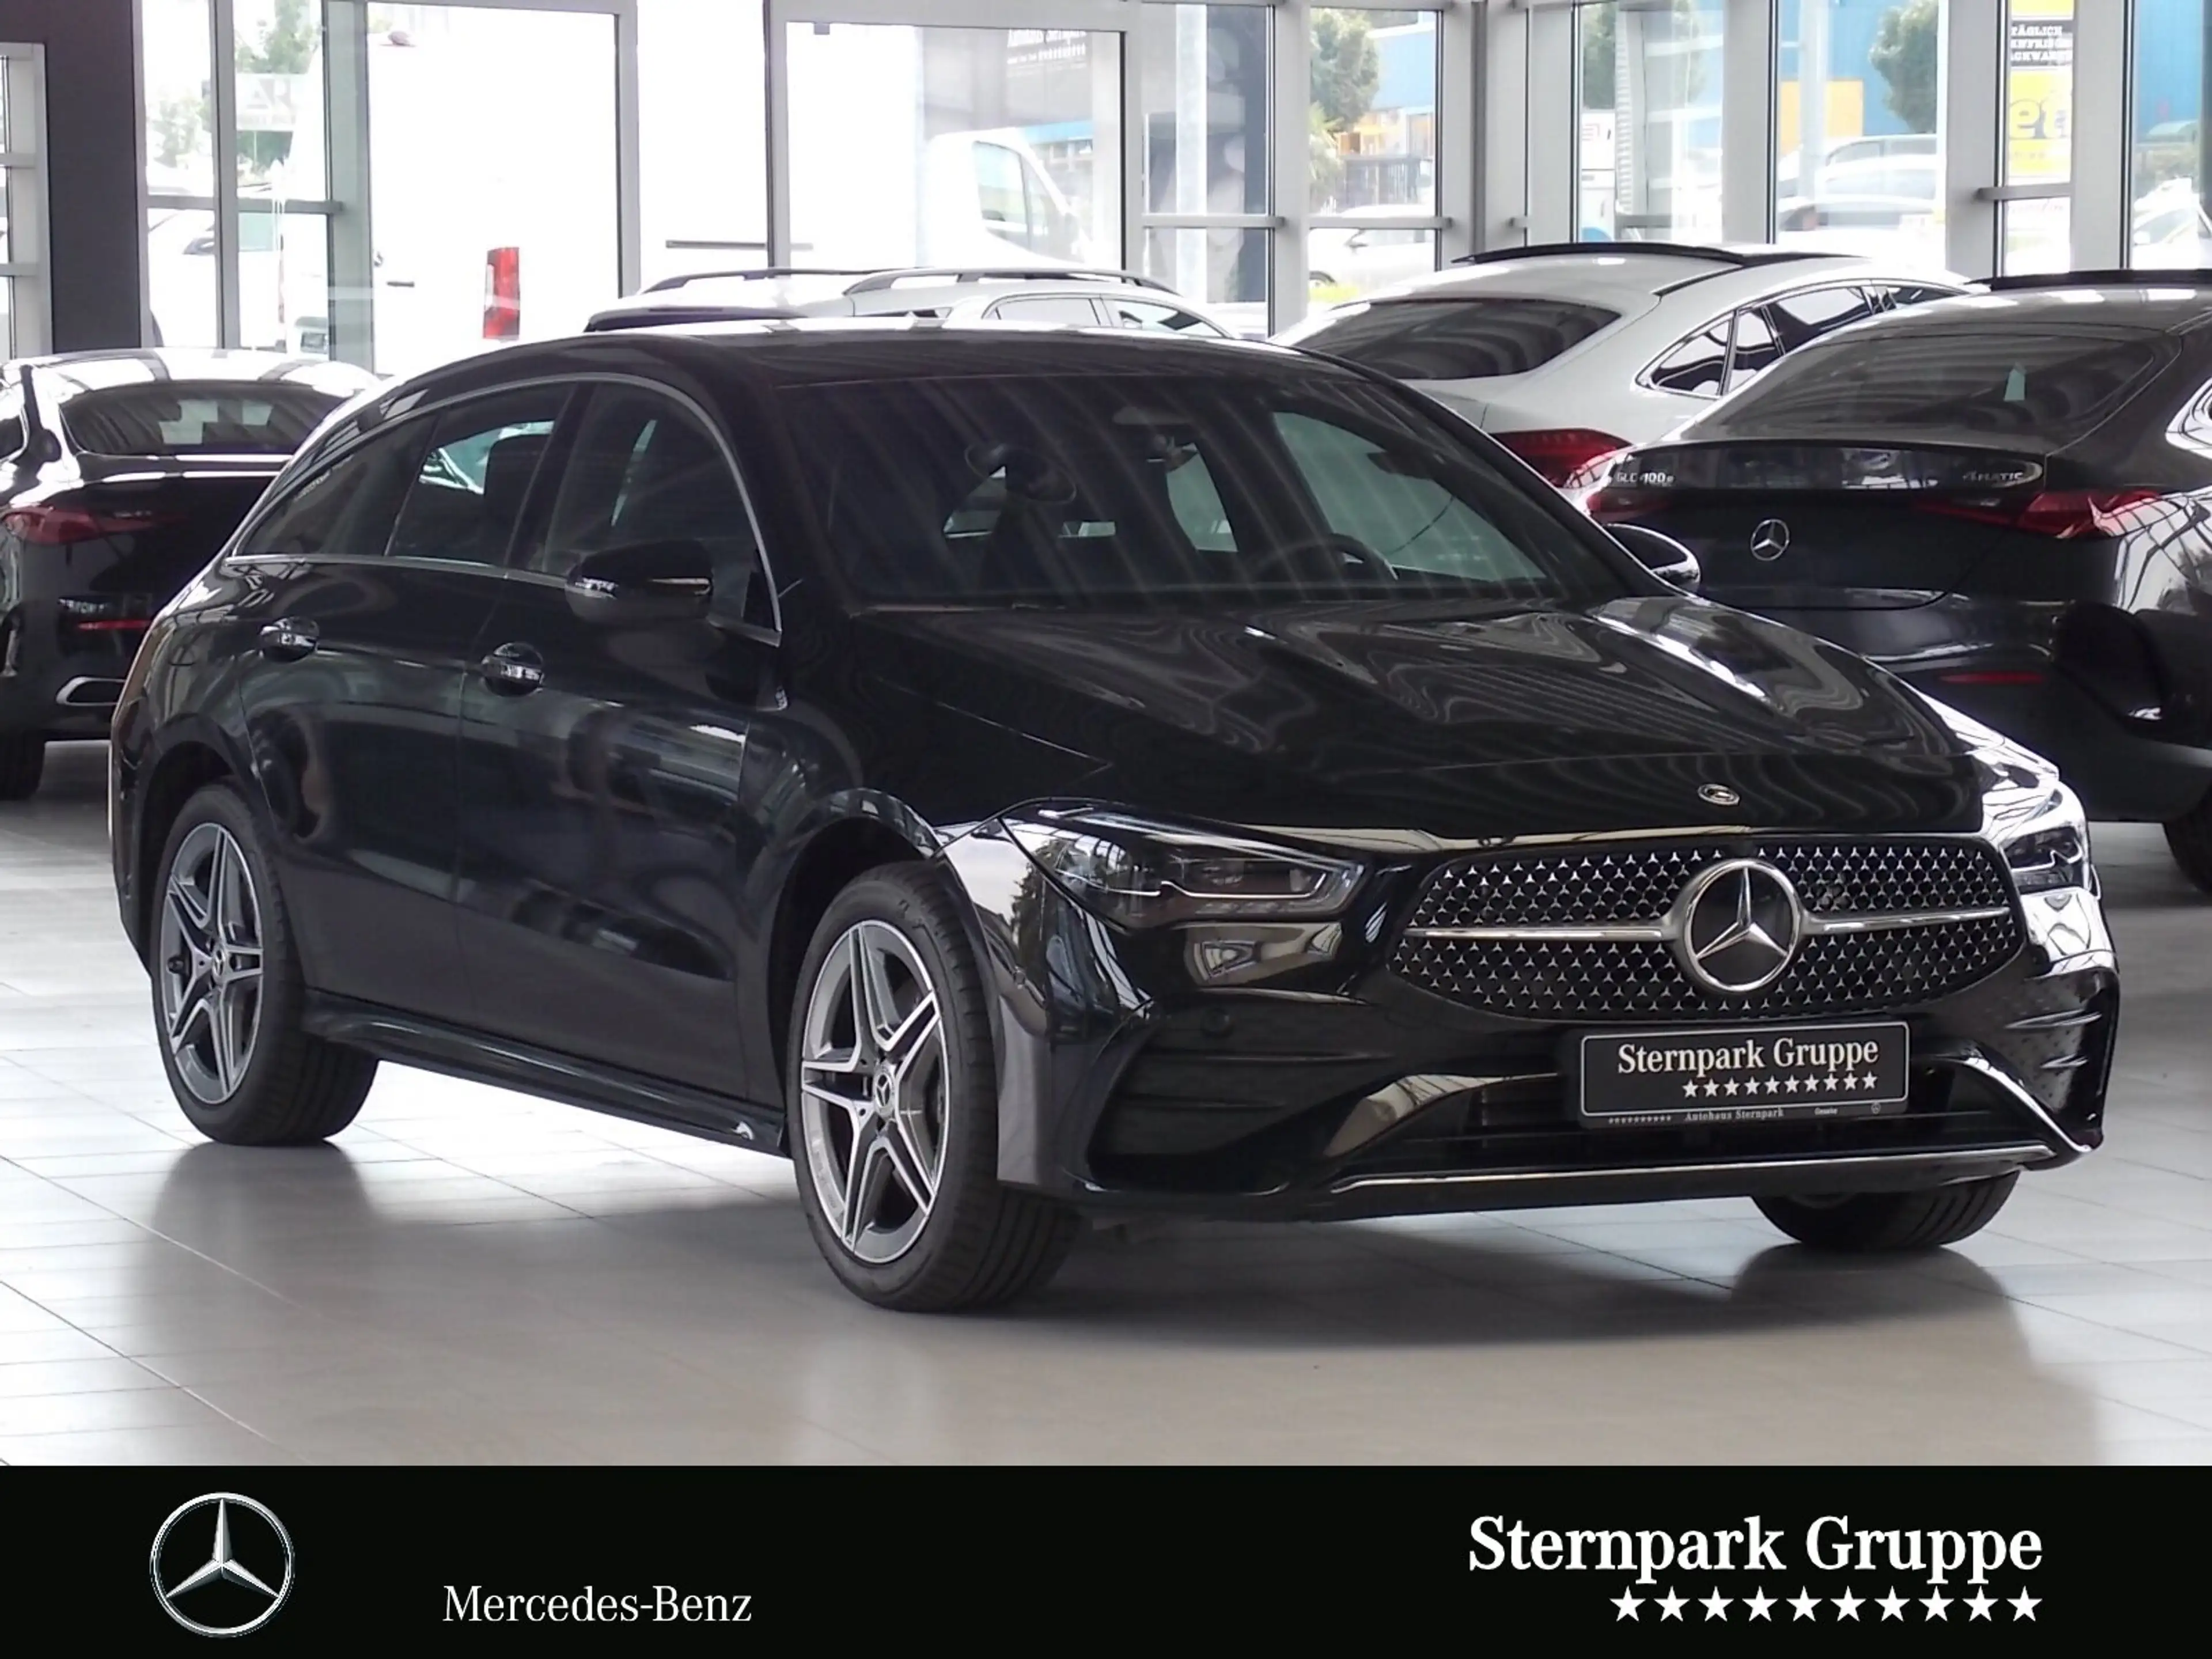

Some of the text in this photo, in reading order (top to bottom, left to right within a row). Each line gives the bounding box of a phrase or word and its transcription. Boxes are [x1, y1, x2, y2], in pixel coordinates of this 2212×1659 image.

[1618, 1037, 1879, 1078] Sternpark Gruppe
[1685, 1107, 1785, 1121] Autohaus Sternpark
